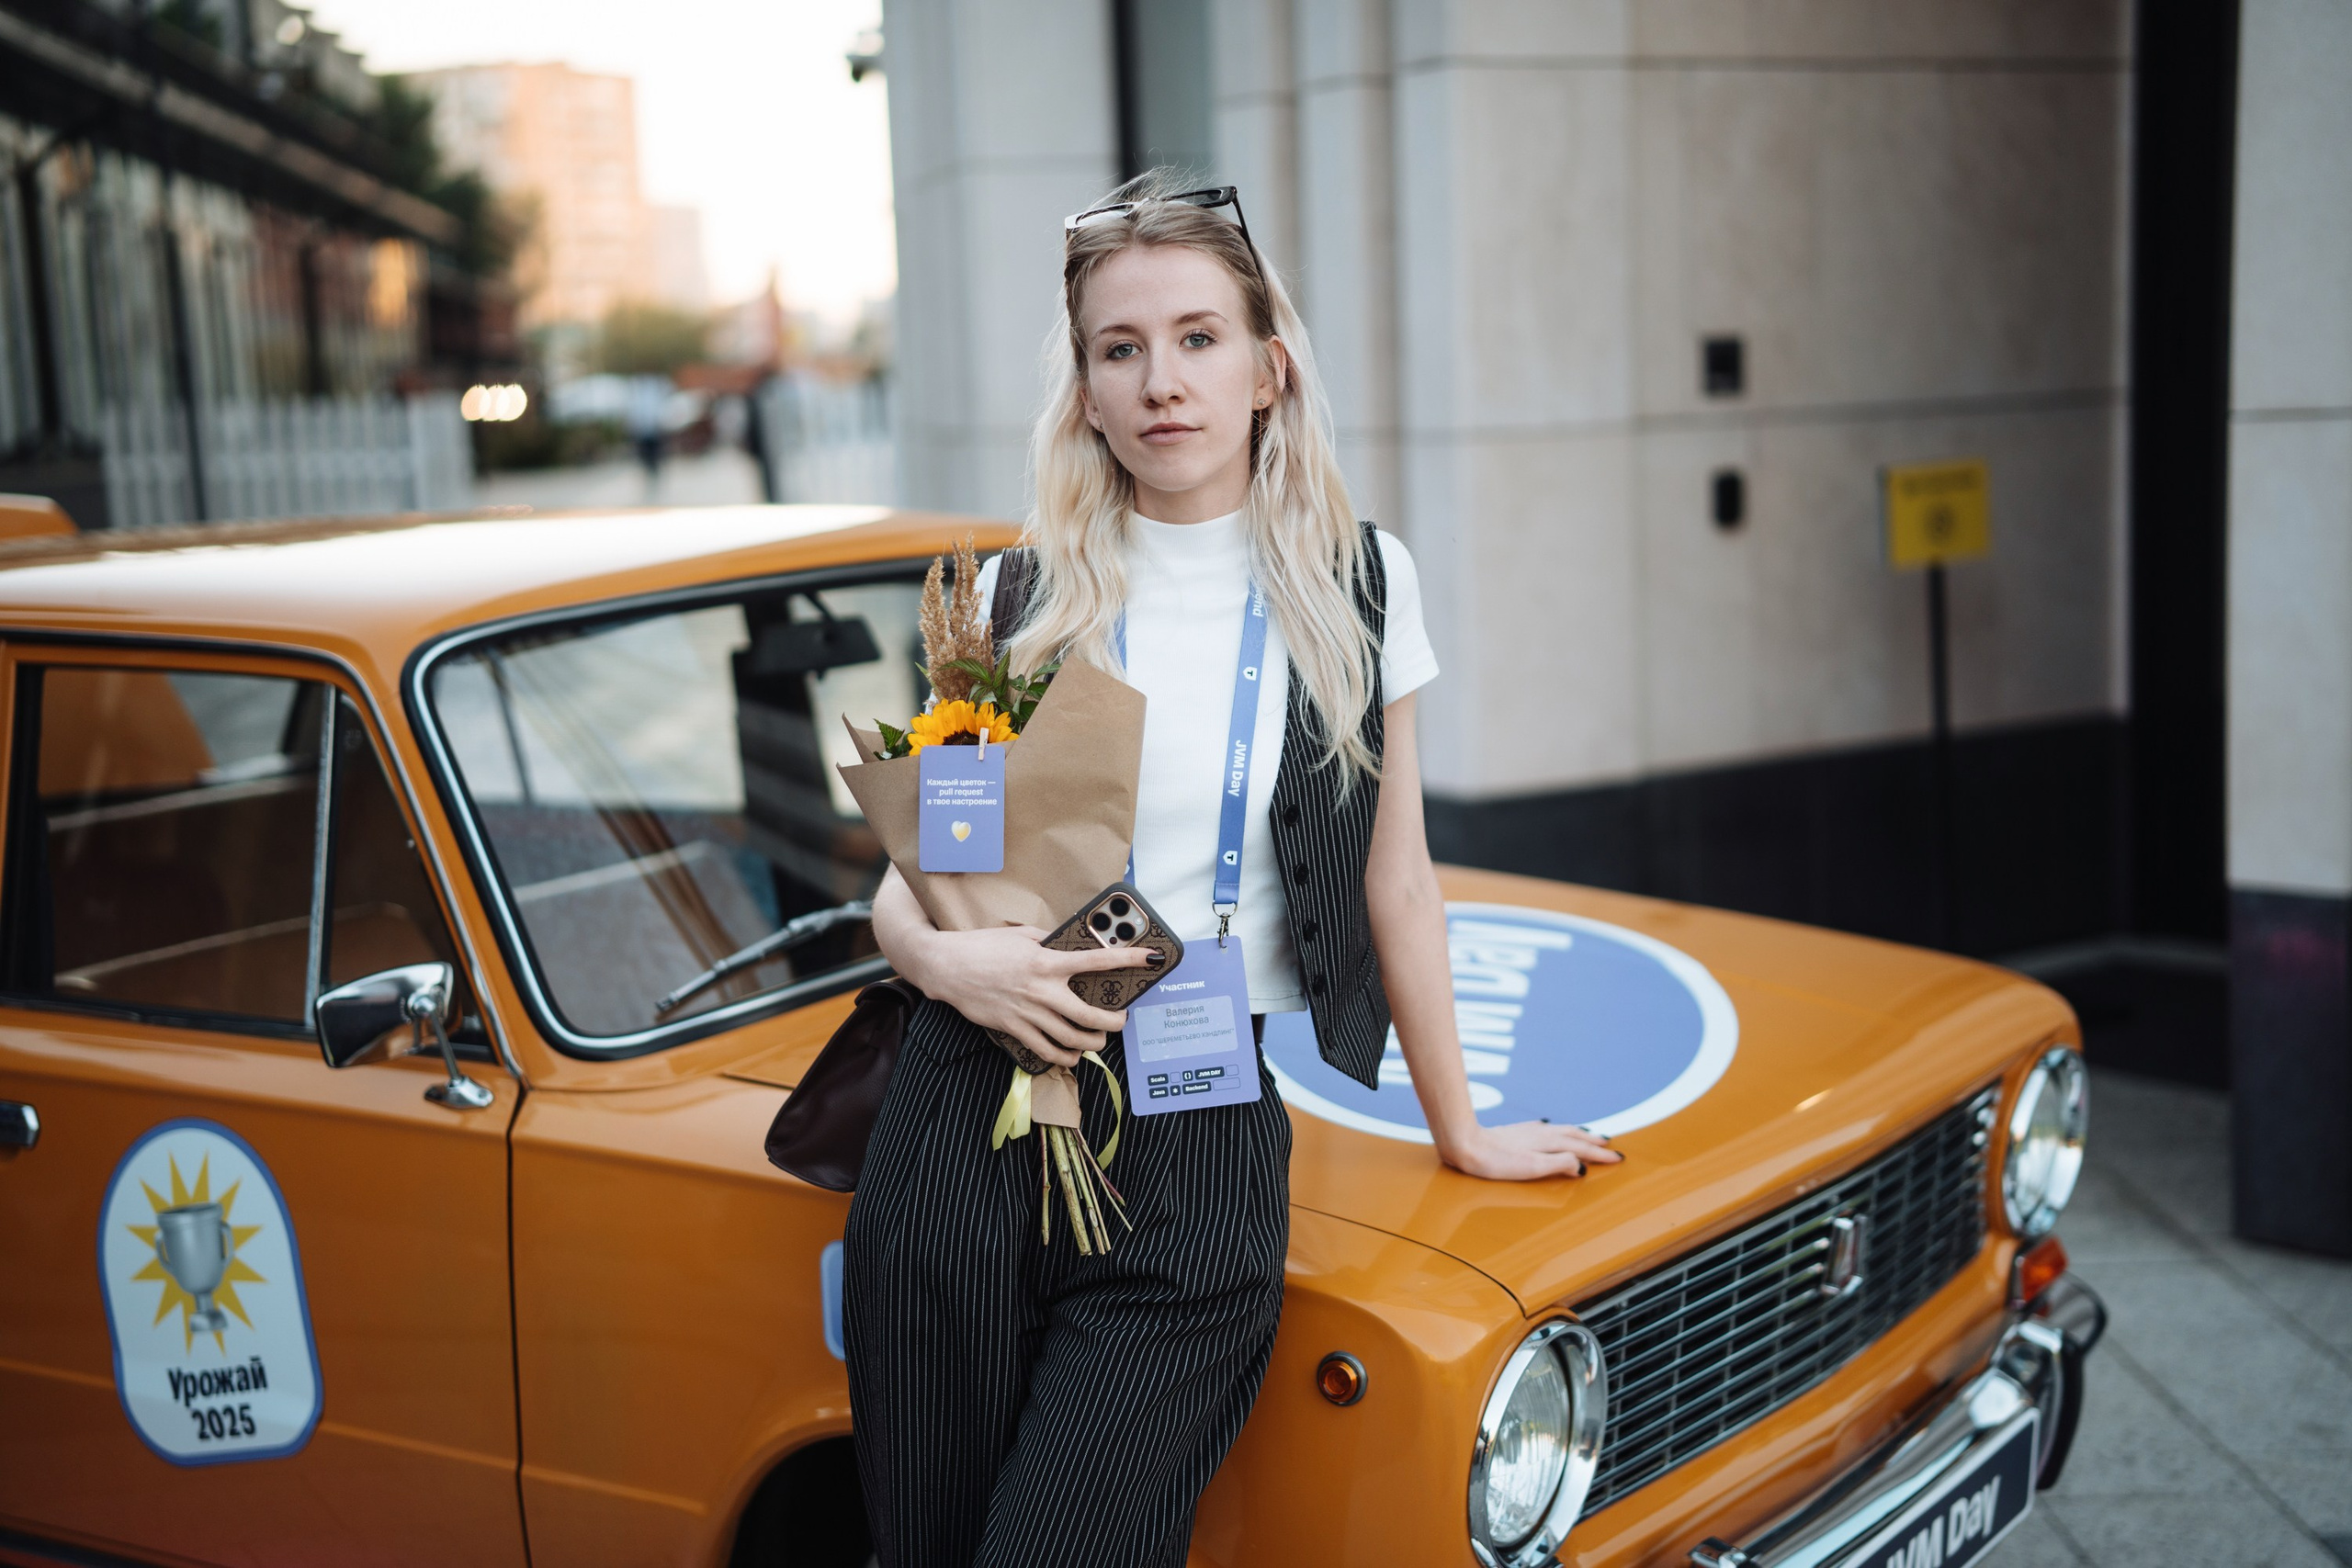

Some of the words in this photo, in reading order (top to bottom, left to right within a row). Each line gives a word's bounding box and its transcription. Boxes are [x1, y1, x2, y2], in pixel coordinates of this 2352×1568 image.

[1232, 739, 1247, 768] JVM
[927, 778, 958, 786] Каждый
[960, 779, 987, 787] цветок
[1227, 771, 1244, 797] Day
[939, 788, 953, 796] pull
[955, 788, 984, 796] request
[952, 798, 997, 807] настроение
[1159, 980, 1205, 993] Участник
[1166, 1005, 1204, 1017] Валерия
[1164, 1016, 1209, 1029] Конюхова
[166, 1356, 268, 1407] Урожай
[191, 1404, 257, 1441] 2025
[1946, 1473, 2002, 1558] Day
